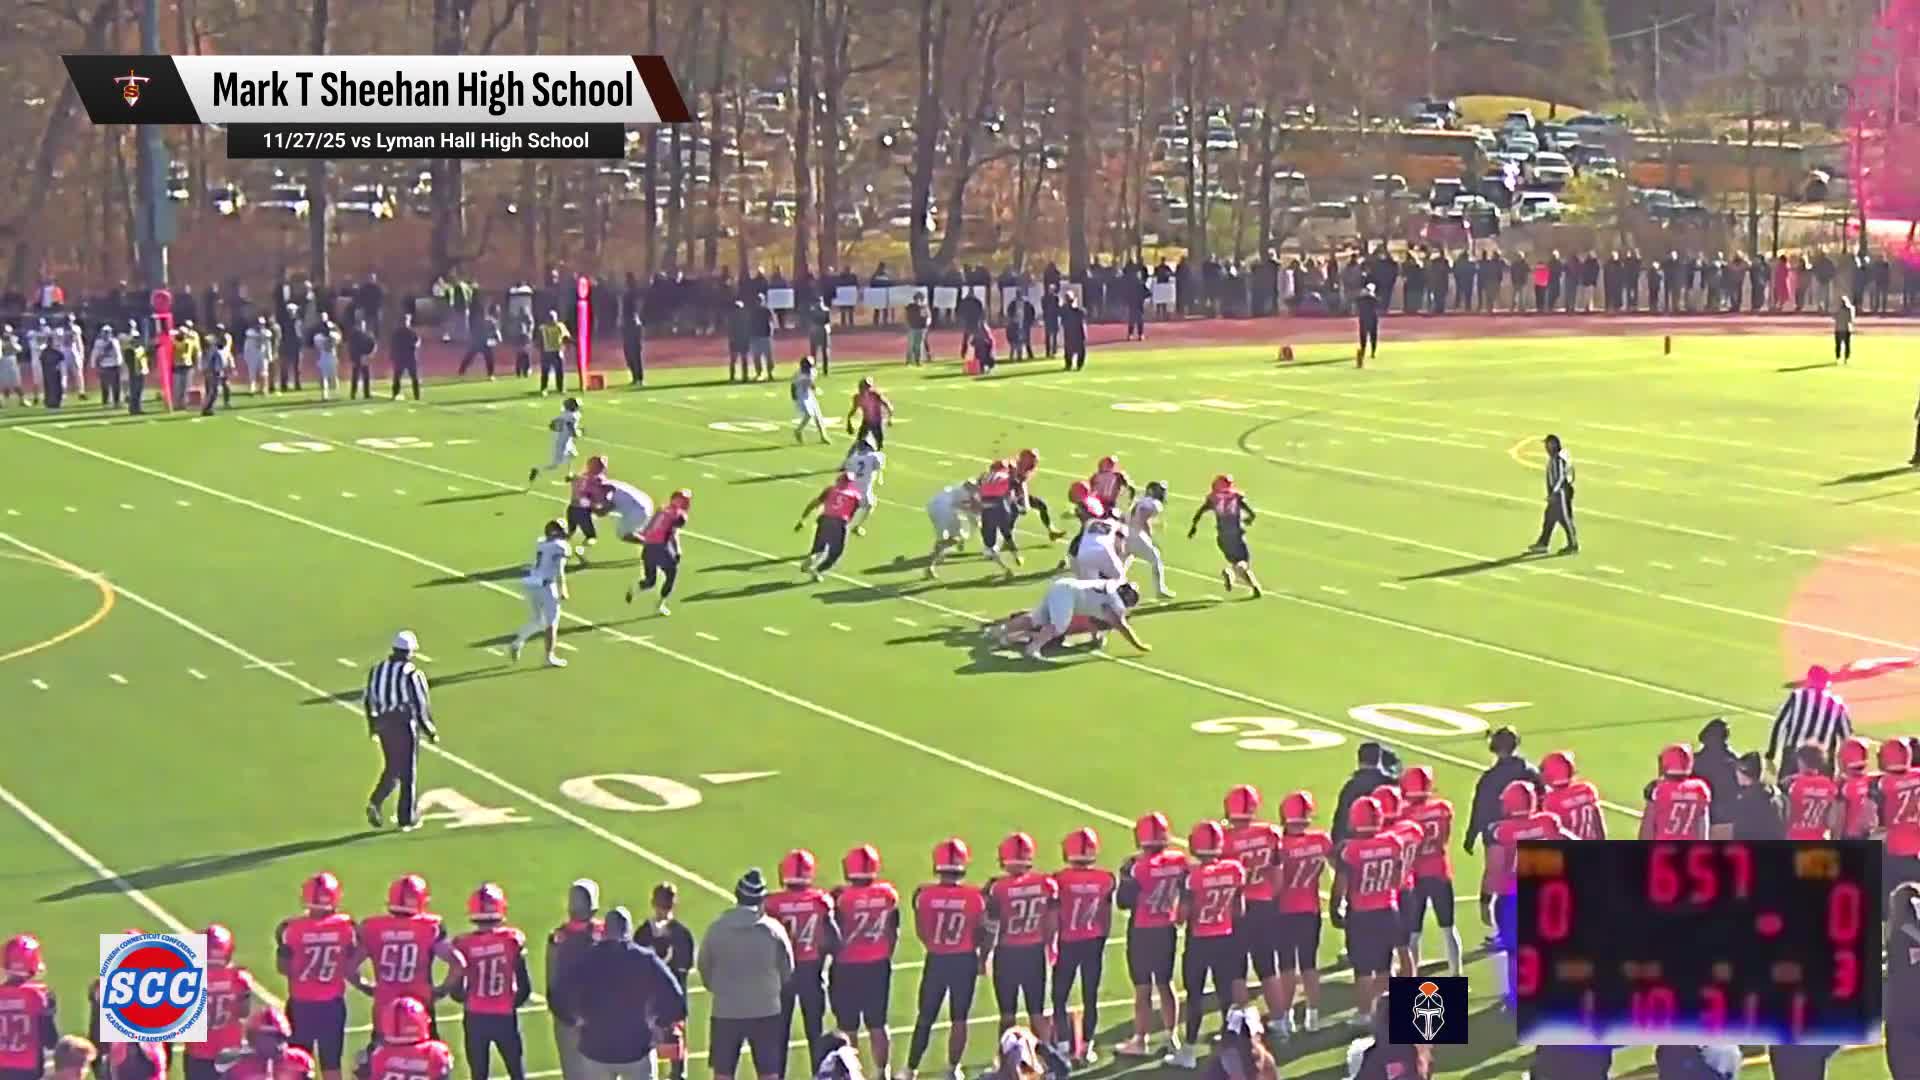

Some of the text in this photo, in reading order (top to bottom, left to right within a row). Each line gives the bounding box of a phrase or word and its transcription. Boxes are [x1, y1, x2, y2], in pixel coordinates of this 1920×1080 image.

[1190, 703, 1491, 751] 30
[1360, 858, 1394, 896] 60
[1007, 897, 1047, 935] 26
[1198, 887, 1237, 923] 27
[300, 944, 342, 983] 76
[477, 955, 507, 997] 16
